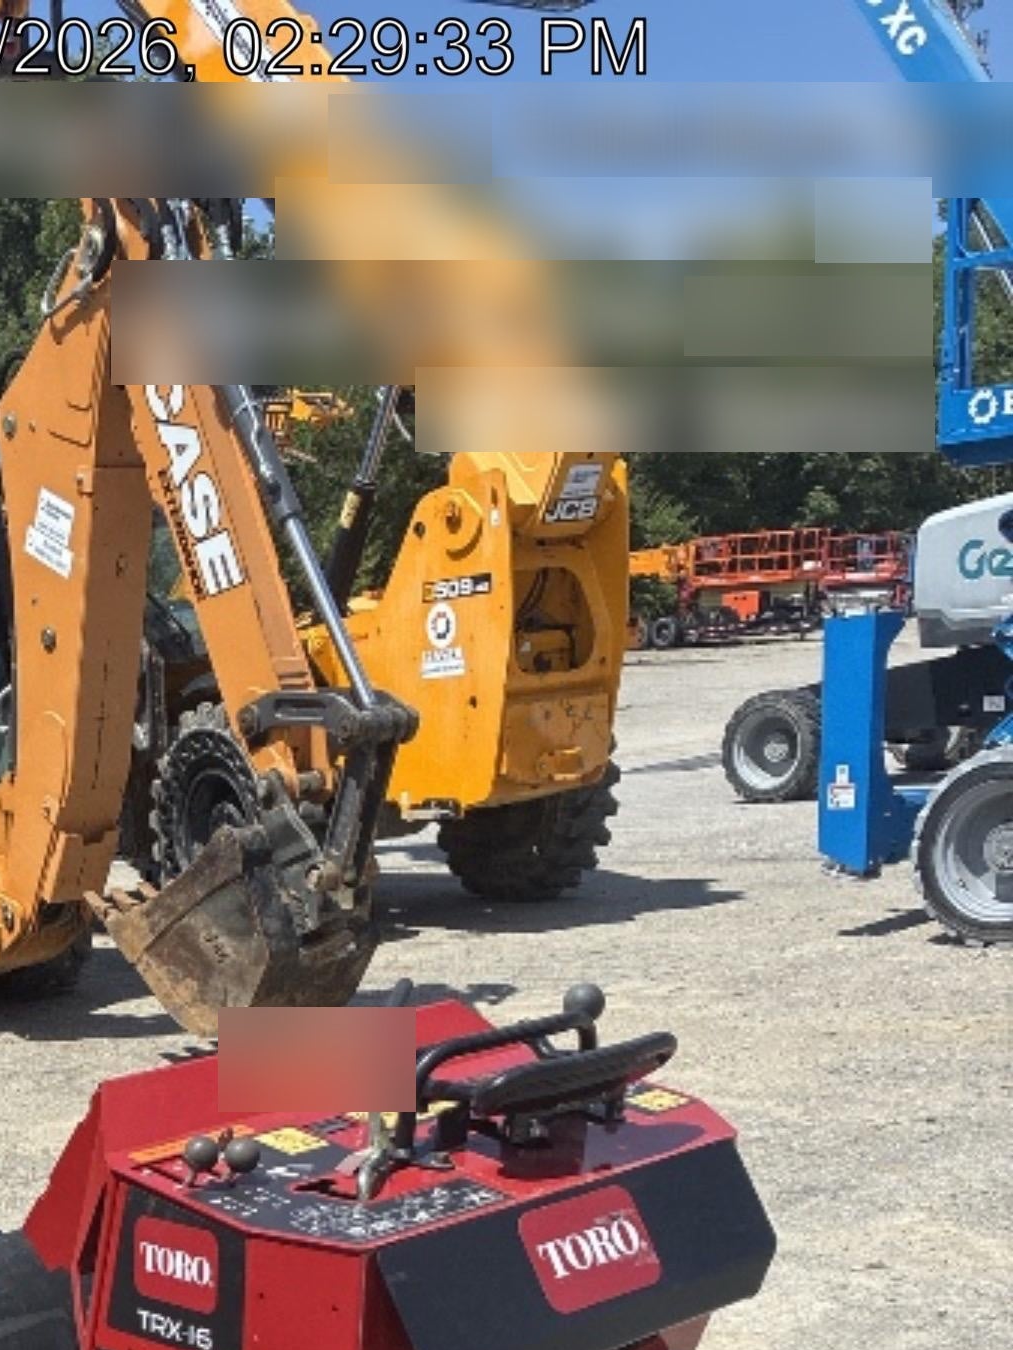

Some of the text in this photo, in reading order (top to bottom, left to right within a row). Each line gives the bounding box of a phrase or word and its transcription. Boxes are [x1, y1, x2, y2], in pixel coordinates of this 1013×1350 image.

[544, 497, 597, 523] JCB
[139, 1240, 212, 1286] TORO
[536, 1217, 640, 1280] TORO
[136, 1307, 213, 1350] TRX-16
